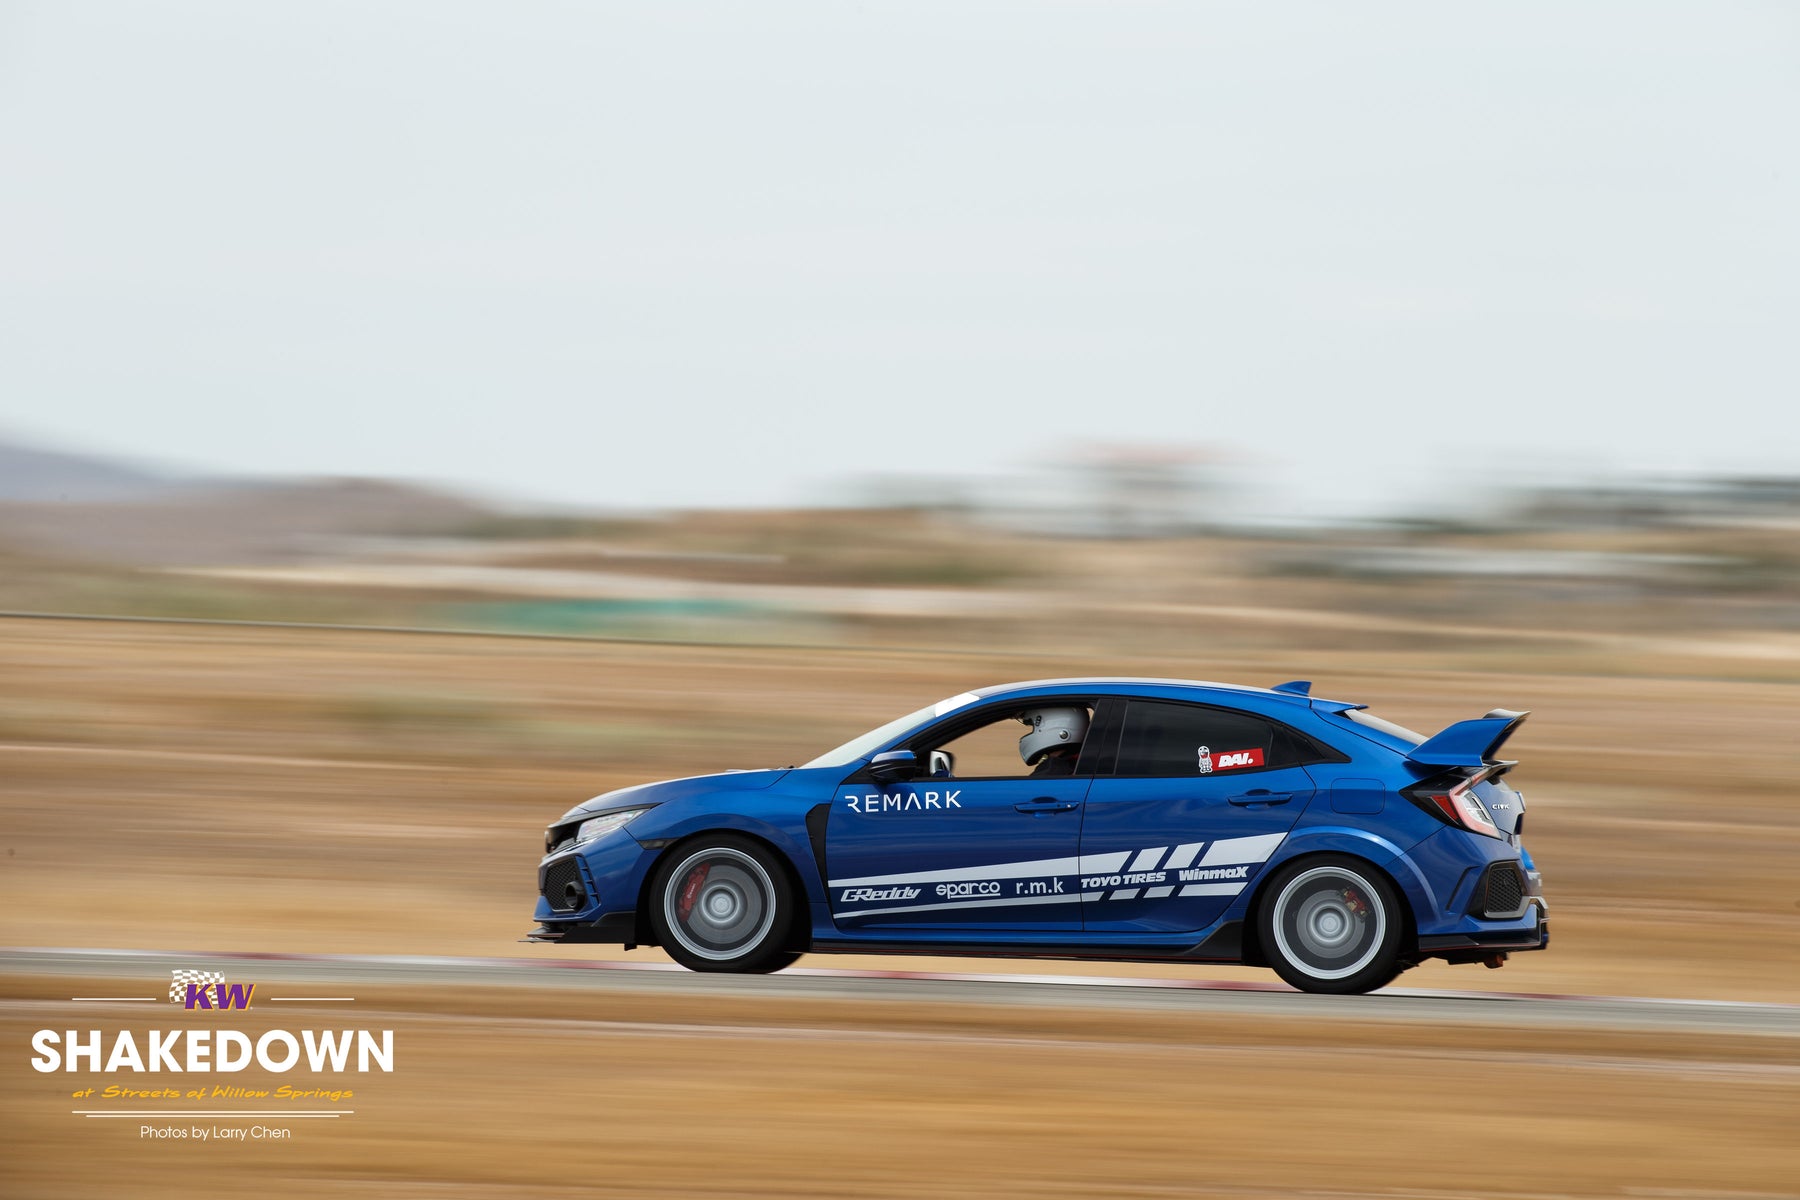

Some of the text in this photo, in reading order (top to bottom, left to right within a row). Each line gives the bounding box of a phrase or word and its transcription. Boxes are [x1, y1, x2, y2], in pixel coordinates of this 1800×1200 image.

[1218, 753, 1254, 768] DAI.
[845, 790, 962, 813] REMARK
[1016, 877, 1064, 895] r.m.k
[1081, 871, 1167, 889] TOYO TIRES
[841, 886, 921, 902] GReddy
[936, 881, 1001, 899] sparco
